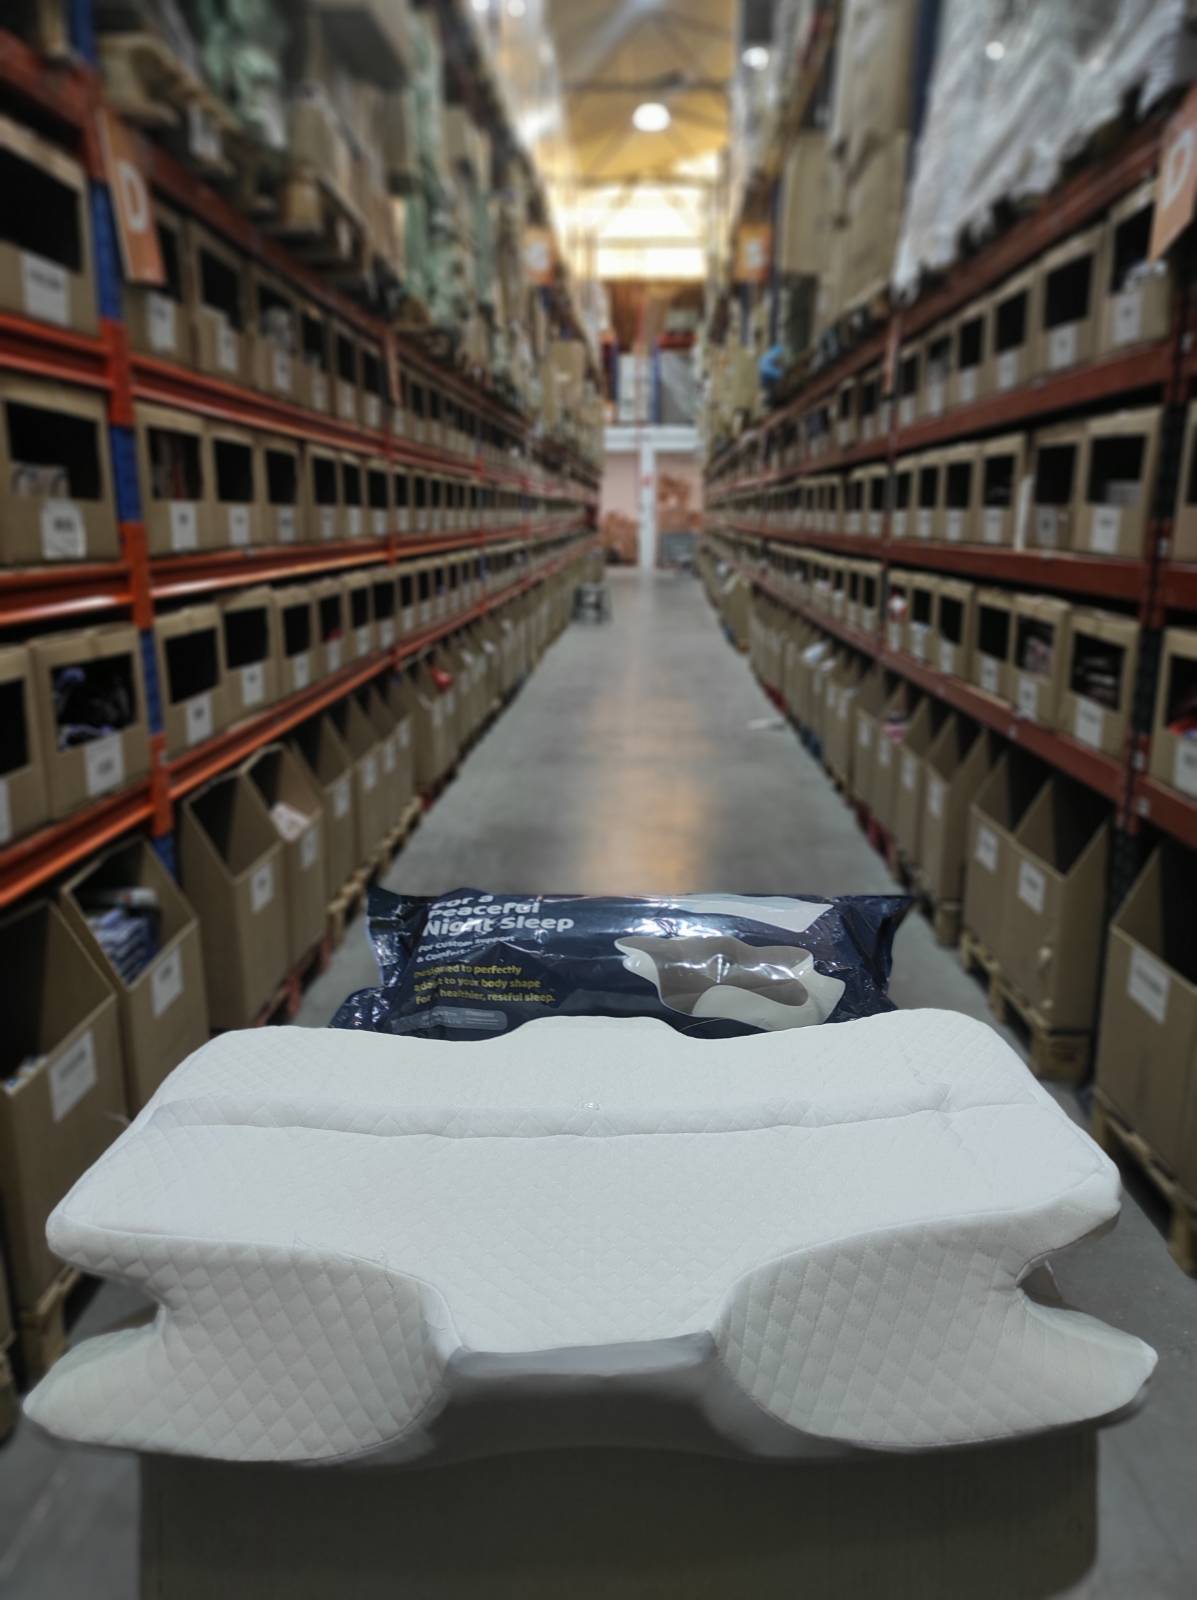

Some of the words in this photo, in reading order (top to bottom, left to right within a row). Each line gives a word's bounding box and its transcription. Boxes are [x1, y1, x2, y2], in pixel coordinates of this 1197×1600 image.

[478, 895, 494, 903] a
[428, 901, 540, 920] Peaceful
[423, 917, 495, 937] Night
[499, 915, 575, 932] Sleep
[414, 964, 460, 978] gned
[461, 964, 473, 973] to
[474, 965, 522, 975] perfectly
[414, 978, 444, 992] adat
[481, 979, 508, 989] body
[510, 979, 542, 989] shape
[487, 992, 523, 1002] restful
